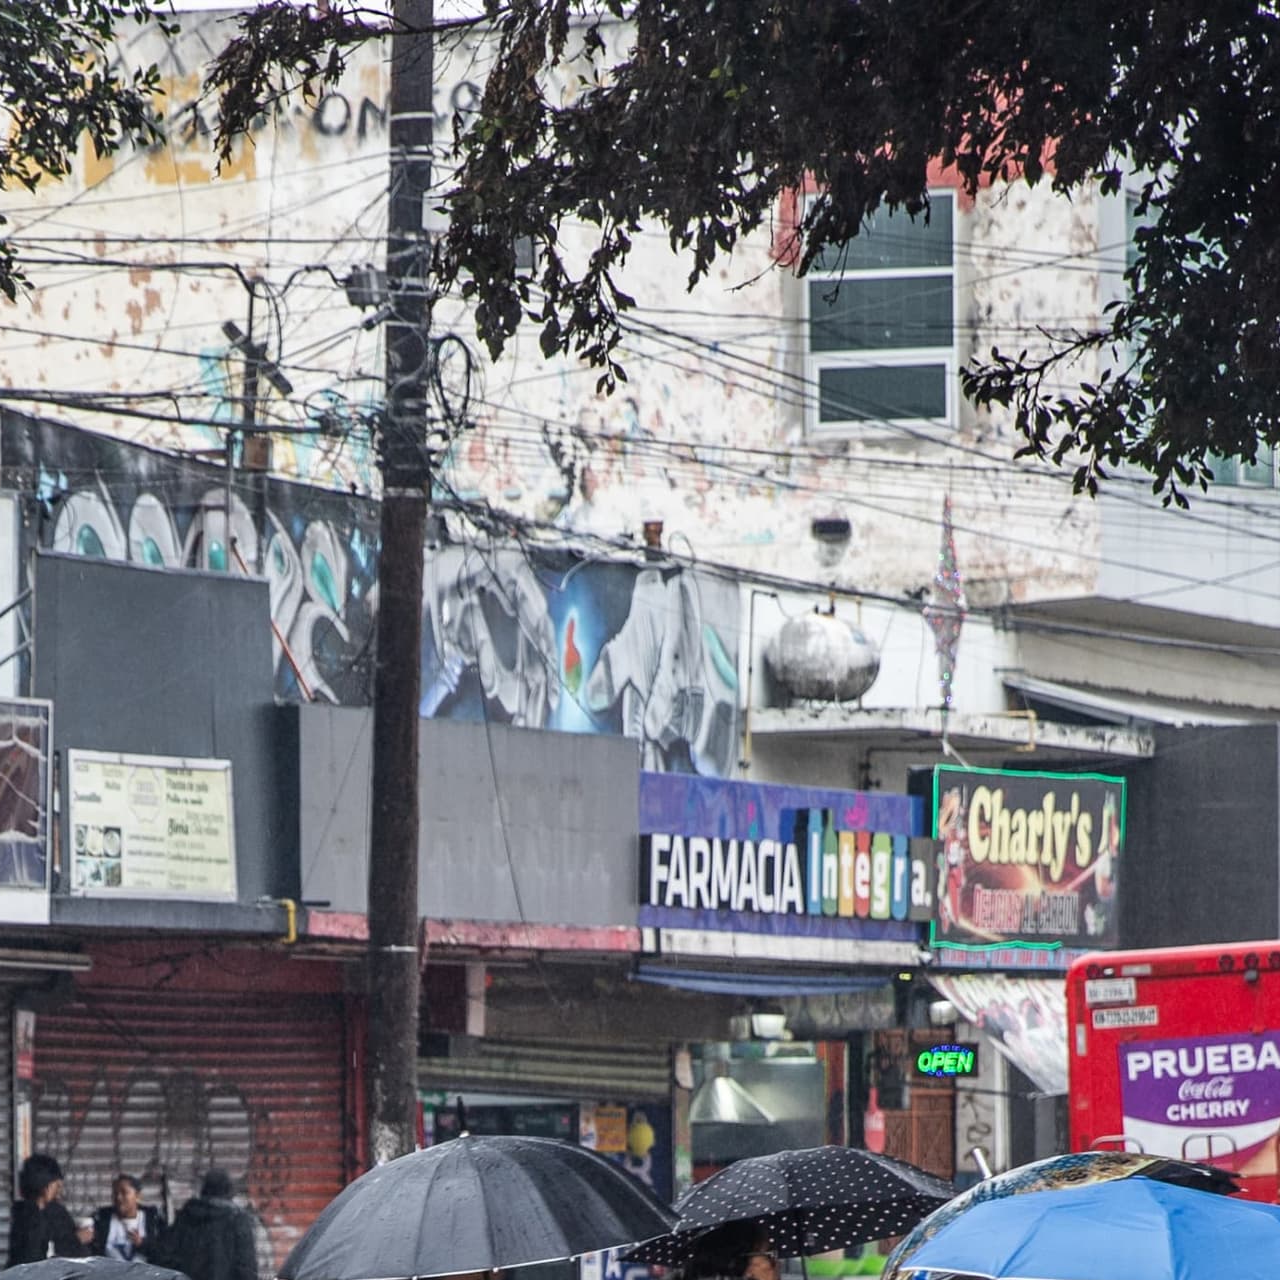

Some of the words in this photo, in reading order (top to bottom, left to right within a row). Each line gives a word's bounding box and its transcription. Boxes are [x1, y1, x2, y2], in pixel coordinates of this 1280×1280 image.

[968, 785, 1092, 883] Charly's
[650, 832, 805, 915] FARMACIA
[918, 1051, 974, 1073] OPEN
[1166, 1099, 1250, 1121] CHERRY
